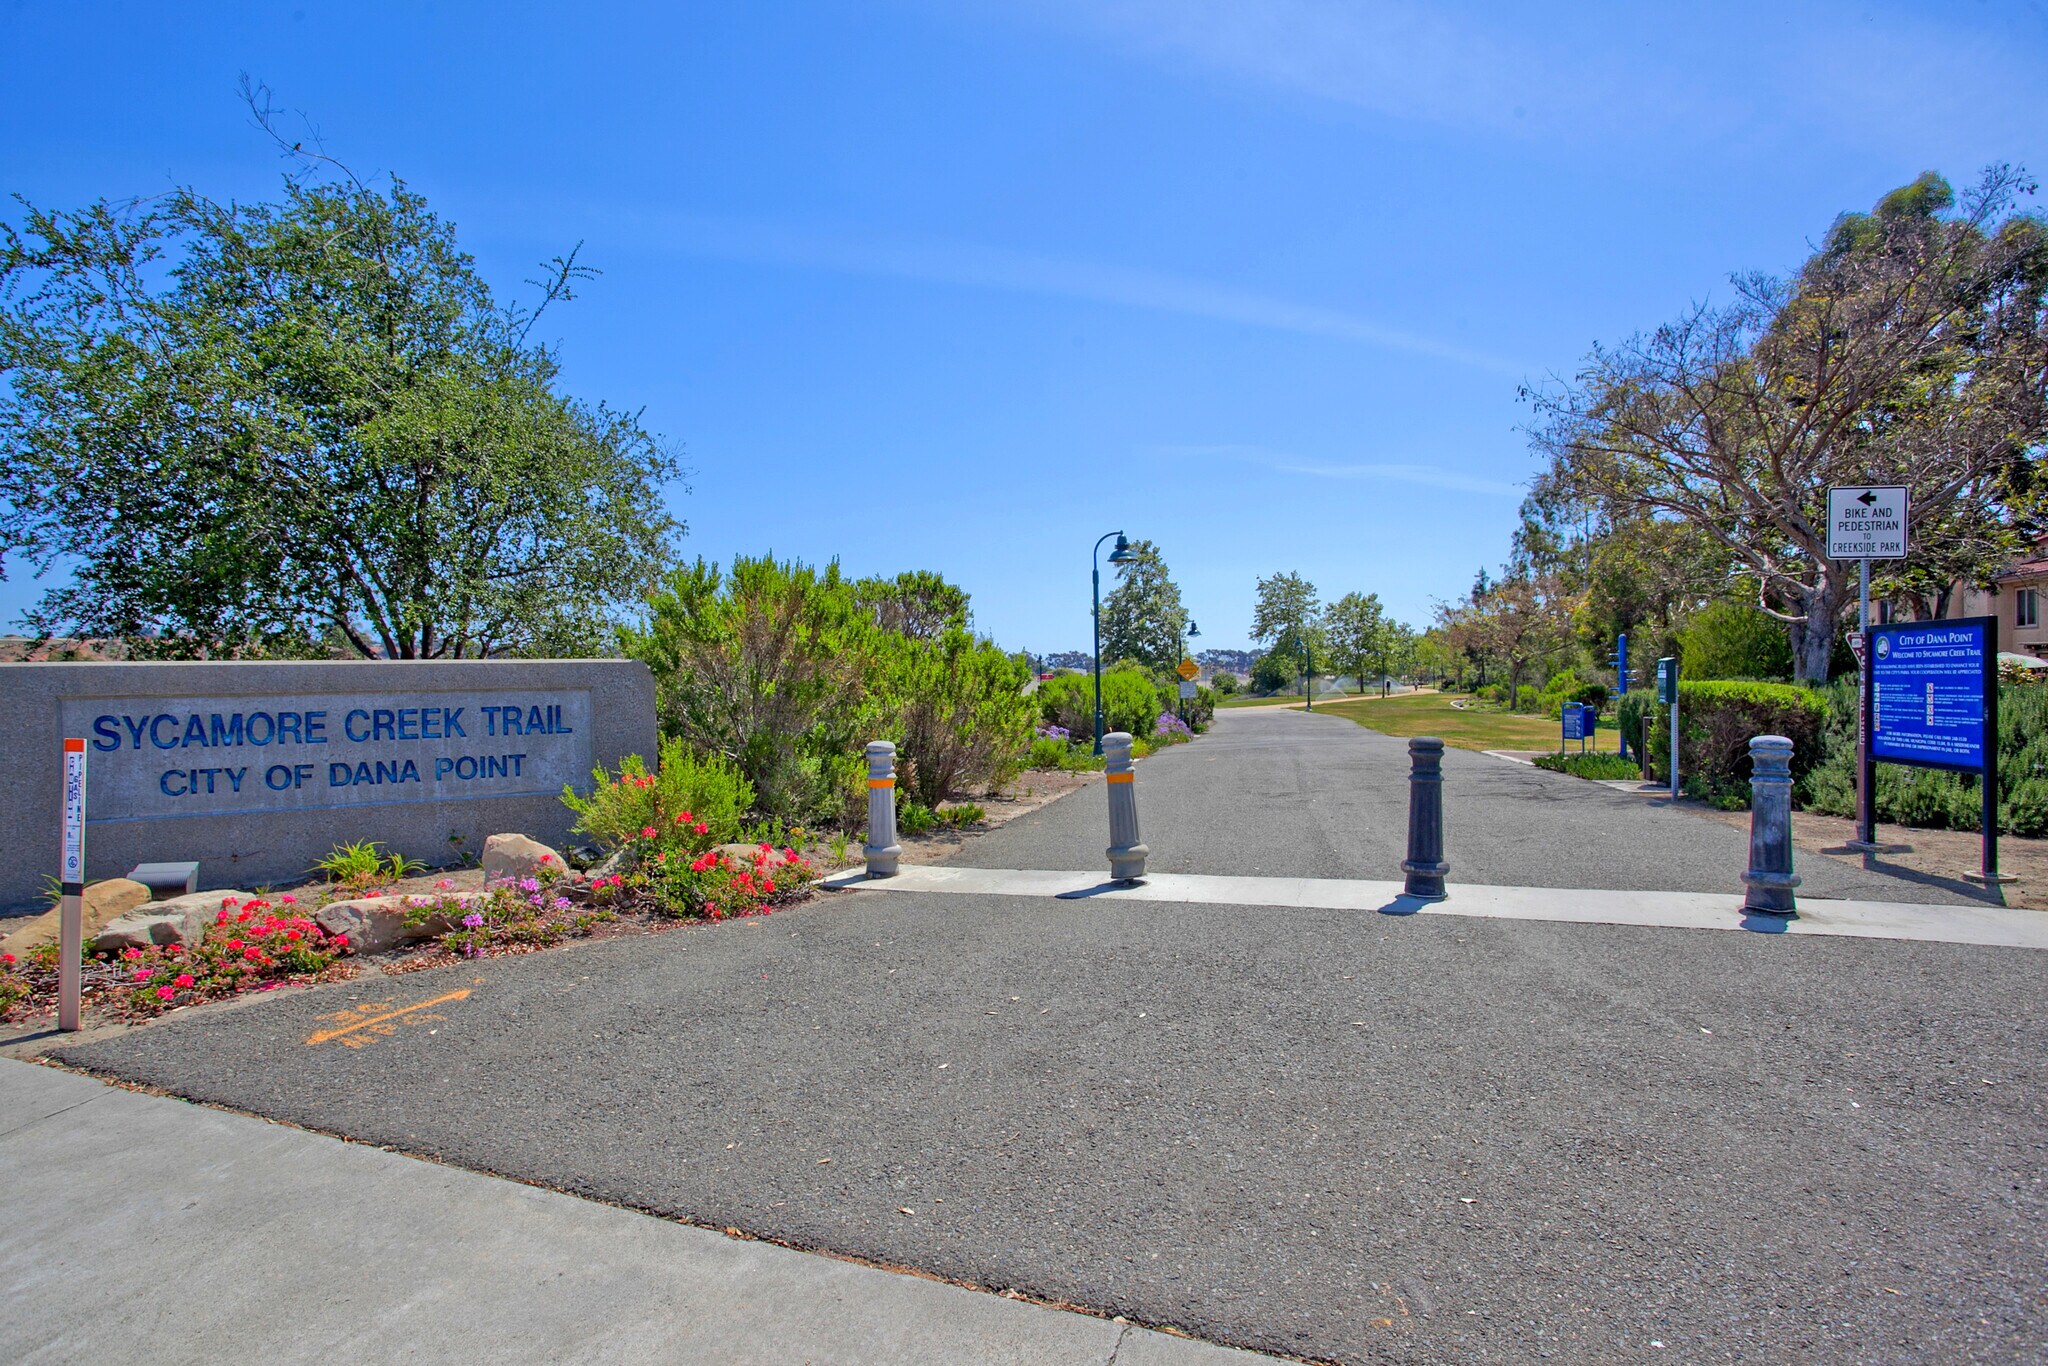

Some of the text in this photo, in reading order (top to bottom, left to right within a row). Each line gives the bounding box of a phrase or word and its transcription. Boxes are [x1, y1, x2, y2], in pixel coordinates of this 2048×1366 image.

[1844, 507, 1893, 518] BIKE AND
[1838, 520, 1899, 531] PEDESTRIAN
[1832, 542, 1901, 553] CREEKSIDE PARK
[1899, 632, 1973, 646] CITY OF DANA POINT
[1892, 651, 1915, 659] WELCOME
[1922, 650, 1949, 658] SYCAMORE
[1949, 648, 1966, 657] CREEK
[1966, 648, 1982, 656] TRAIL
[93, 705, 573, 751] SYCAMORE CREEK TRAIL
[160, 754, 527, 797] CITY OF DANA POINT
